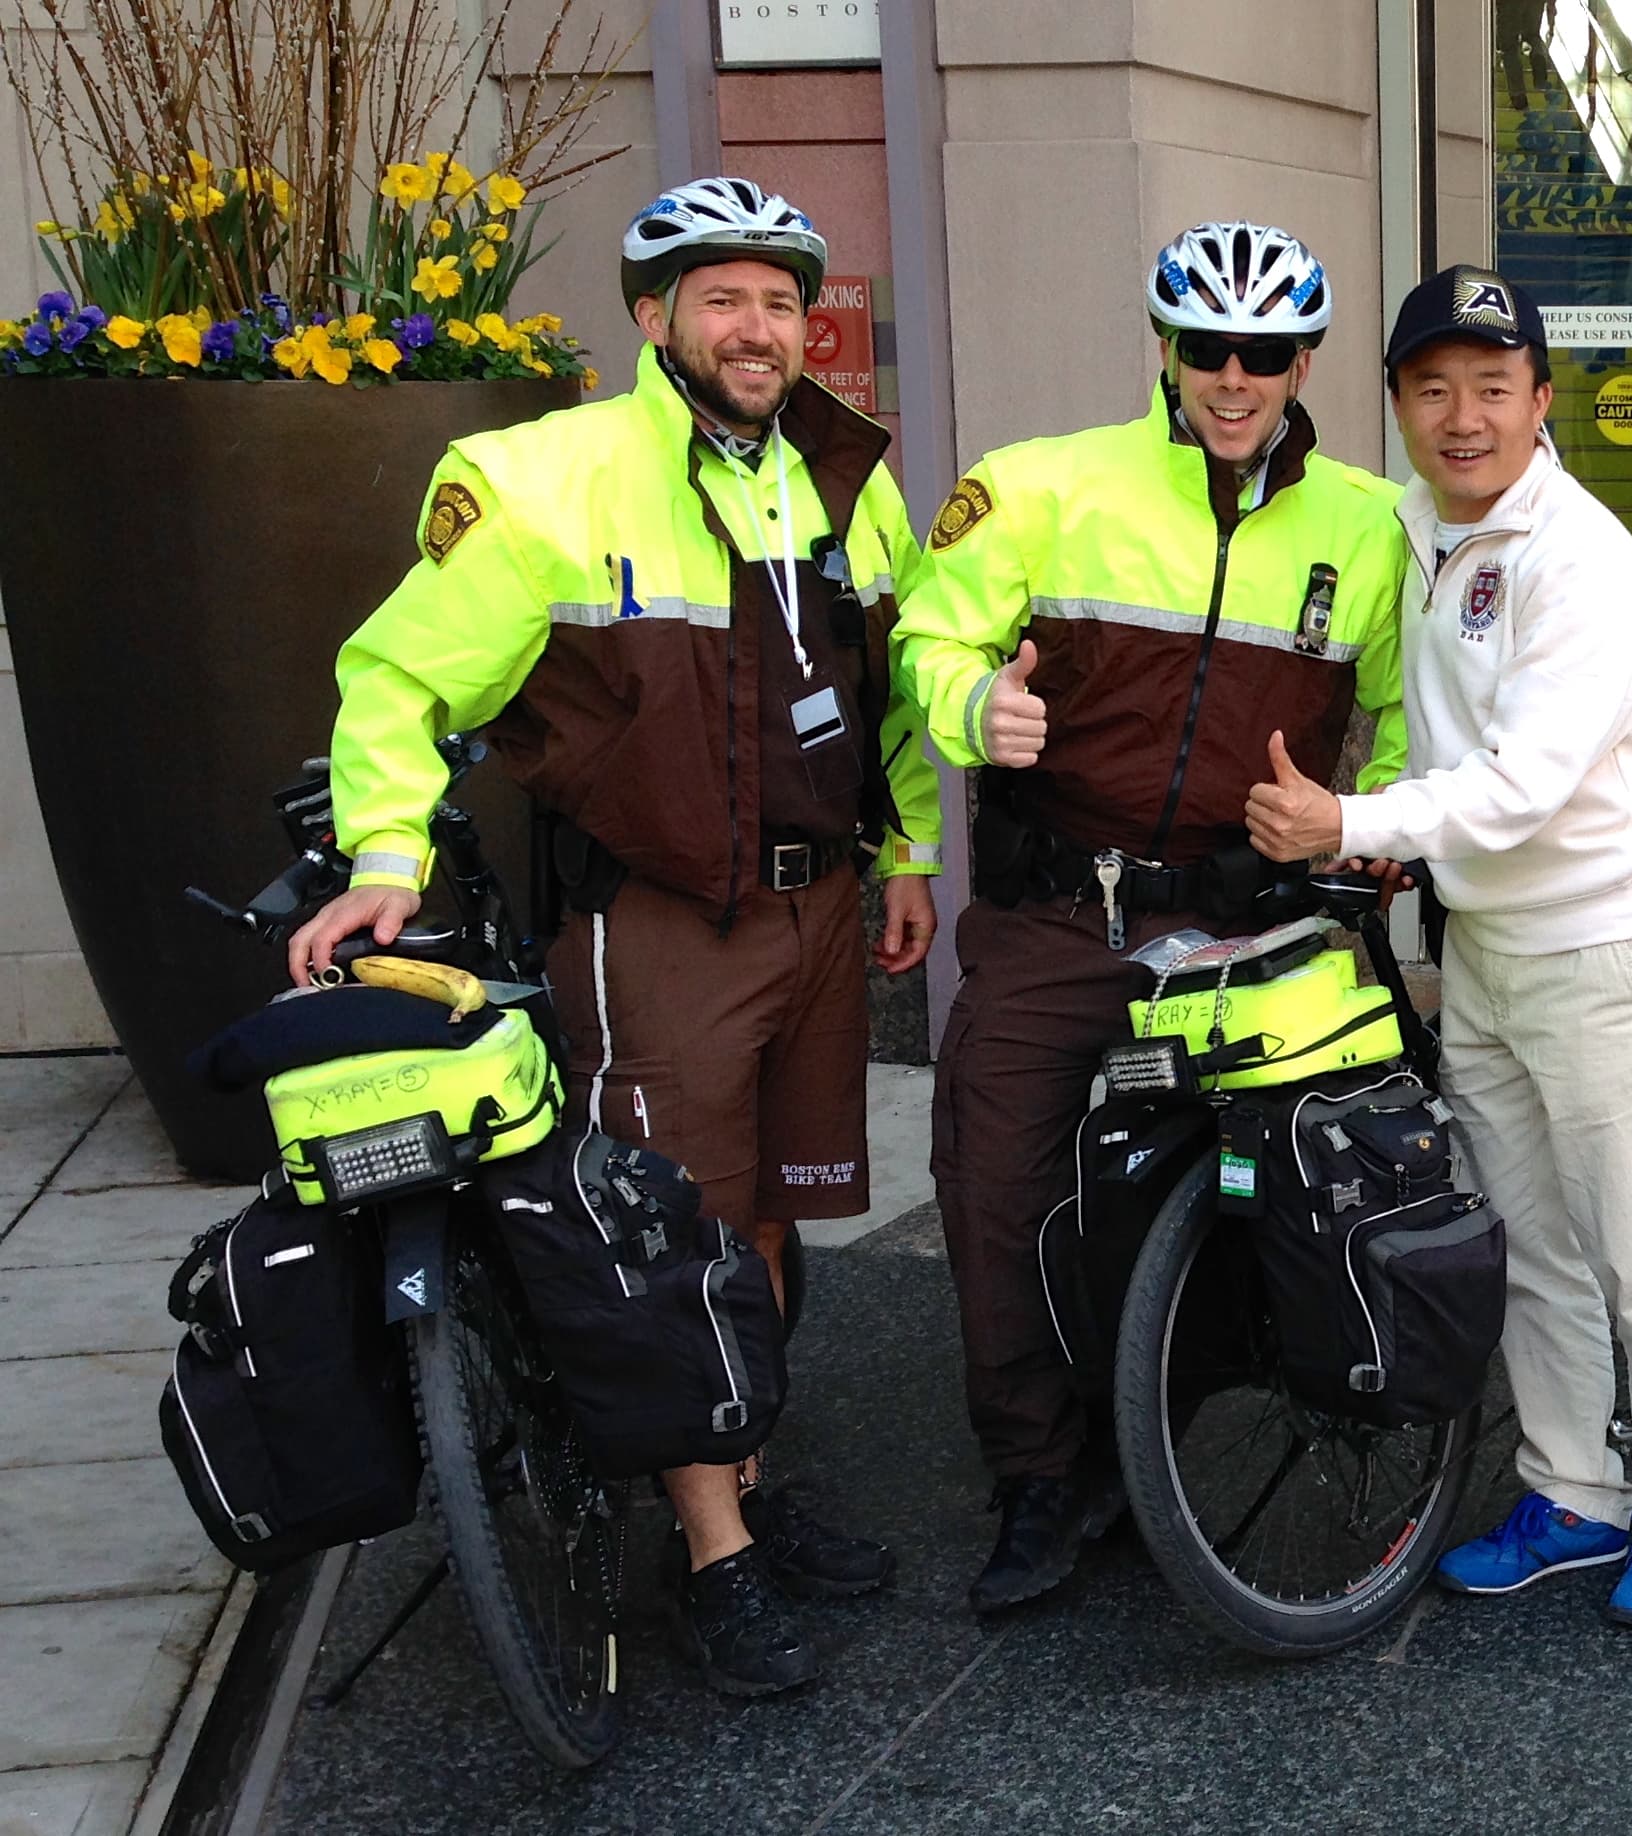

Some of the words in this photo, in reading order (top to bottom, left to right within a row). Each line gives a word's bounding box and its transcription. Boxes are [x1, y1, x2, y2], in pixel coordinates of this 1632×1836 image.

[810, 285, 864, 308] OKING
[1577, 312, 1592, 323] US
[1547, 330, 1580, 340] EASE
[1584, 330, 1607, 340] USE
[830, 373, 853, 385] FEET
[856, 373, 871, 386] OF
[838, 391, 866, 406] ANCE
[780, 1164, 830, 1175] BOSTON
[833, 1162, 855, 1174] EMS
[785, 1174, 815, 1185] BIKE
[820, 1173, 852, 1184] TEAM
[1352, 1566, 1408, 1613] BONTRAGER
